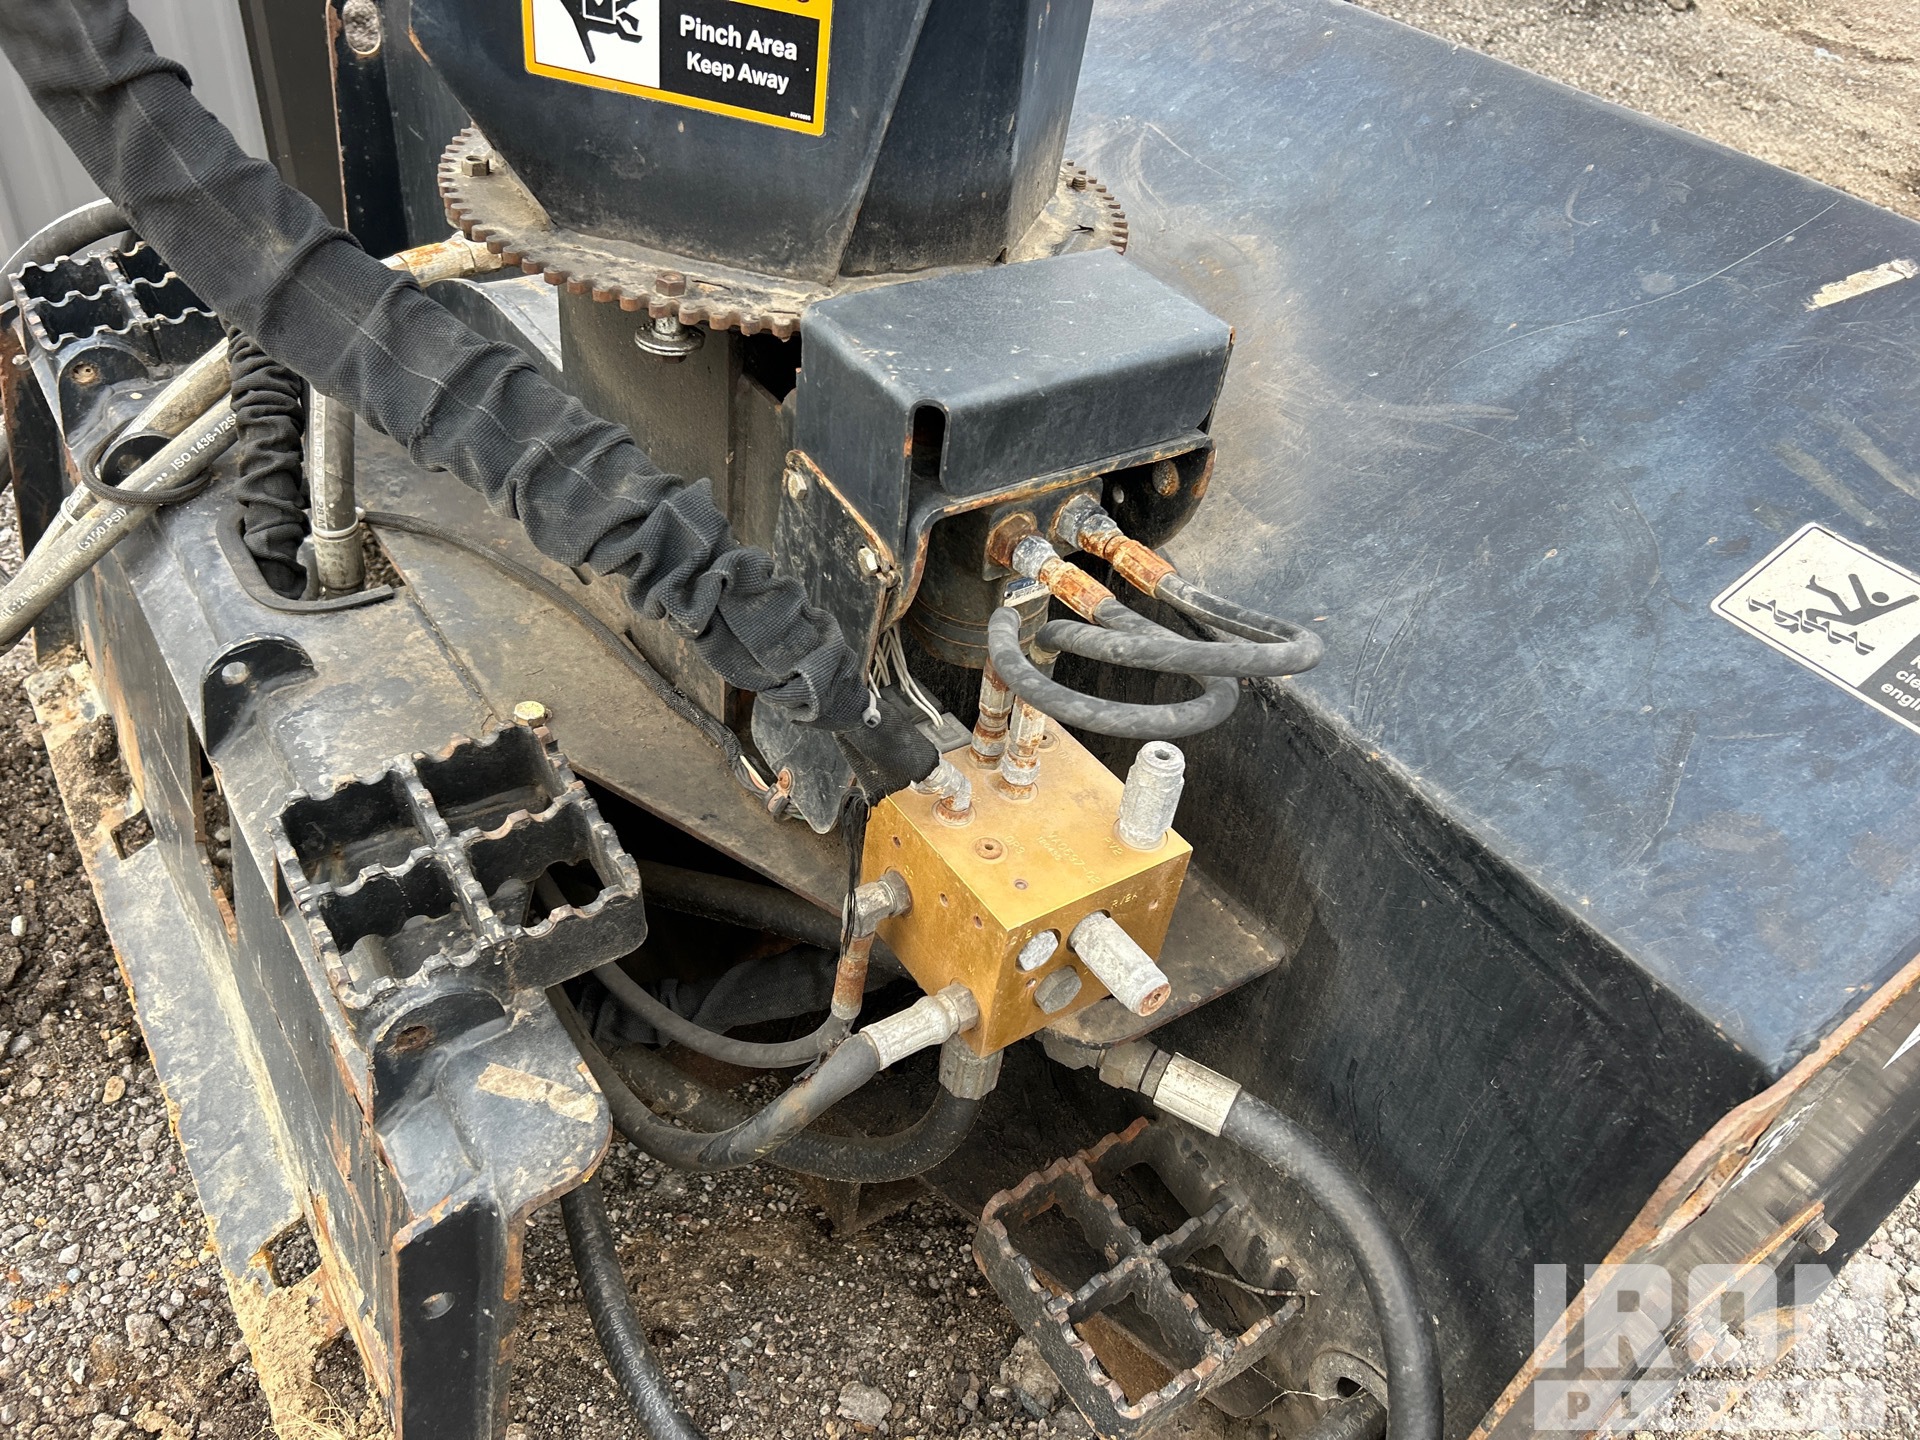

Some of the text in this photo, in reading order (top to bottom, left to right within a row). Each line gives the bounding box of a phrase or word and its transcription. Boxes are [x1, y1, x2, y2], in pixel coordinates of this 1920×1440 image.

[679, 14, 798, 61] Pinch Area
[686, 51, 790, 95] Keep Away
[170, 452, 192, 471] ISO
[104, 506, 128, 531] PSI)
[1896, 670, 1920, 691] cle
[627, 1357, 642, 1376] PSI
